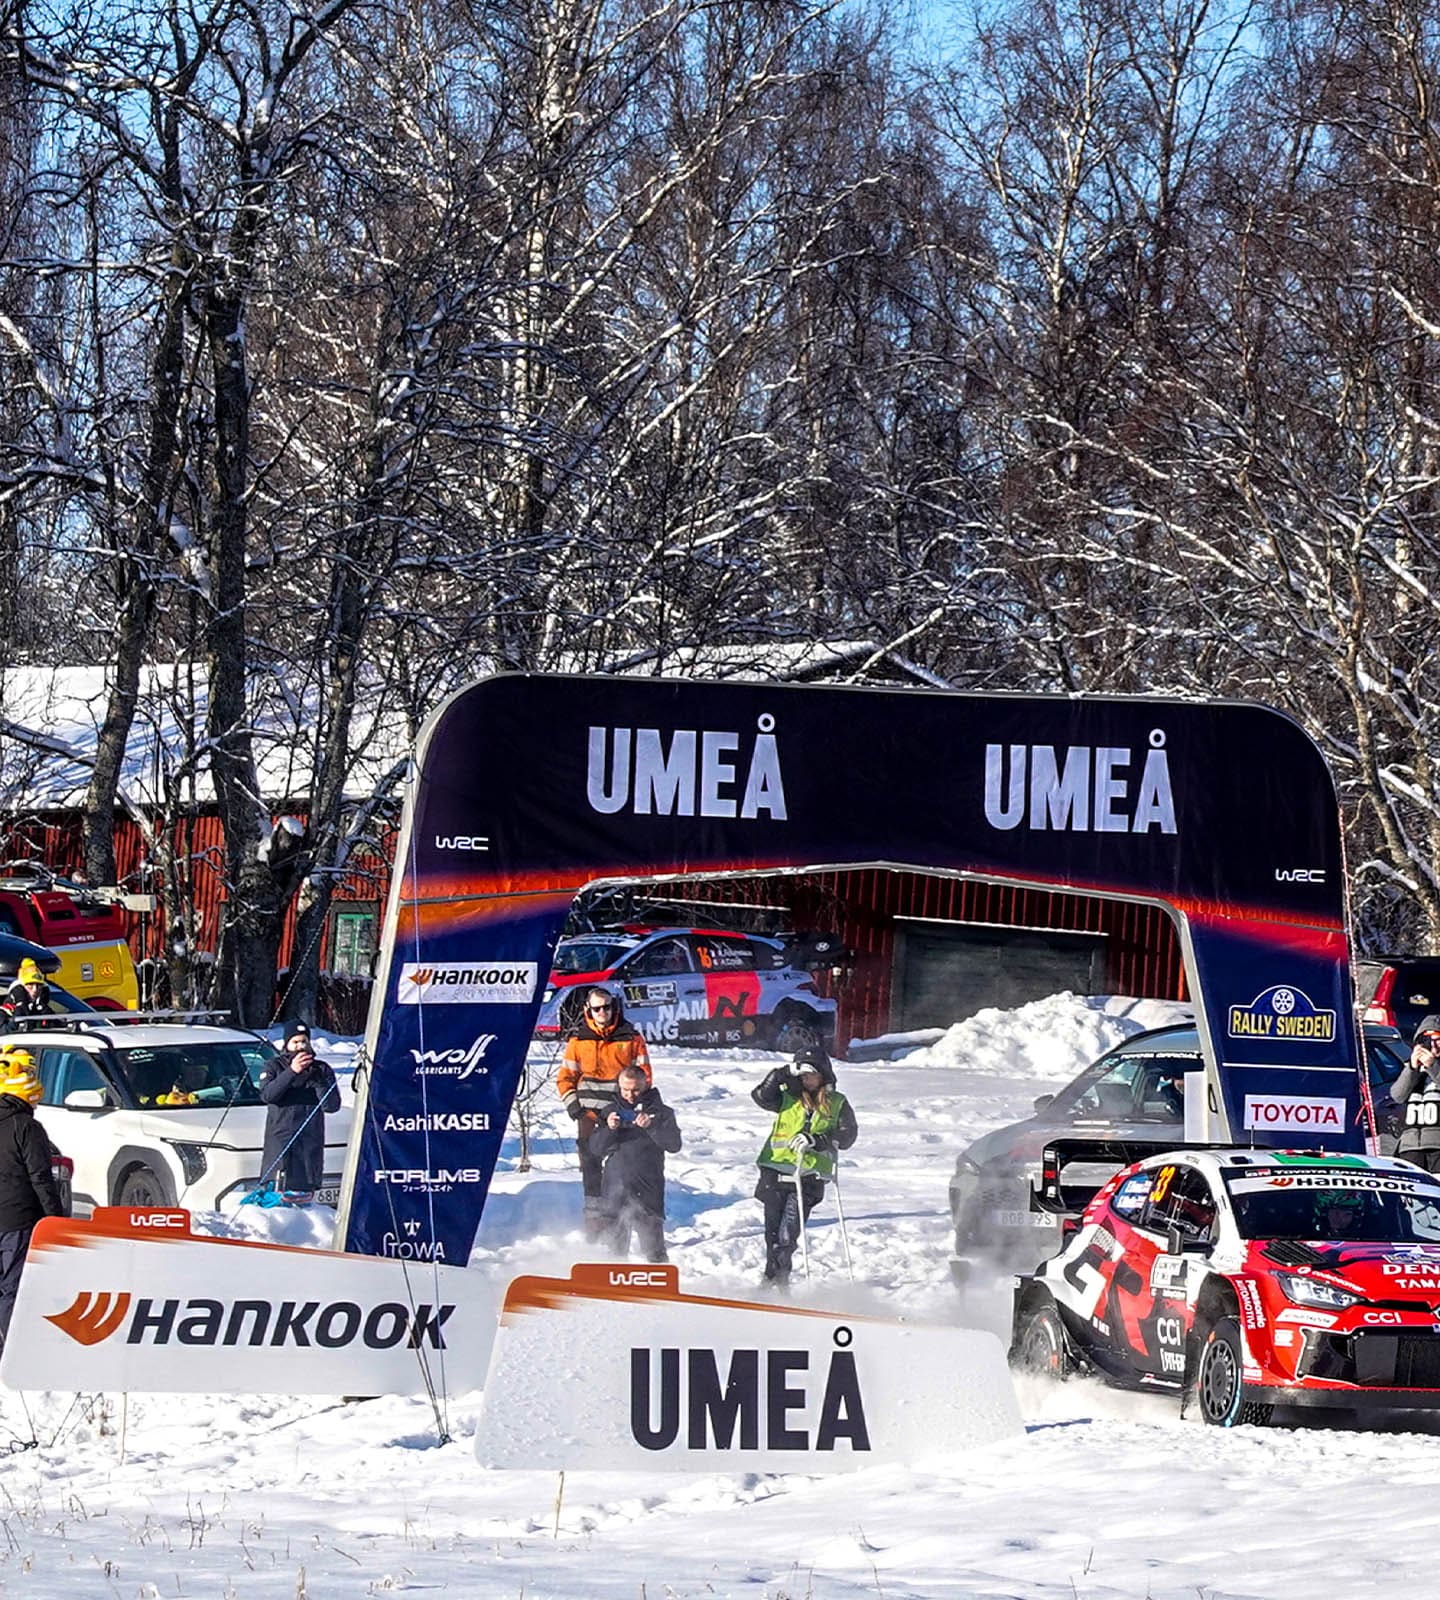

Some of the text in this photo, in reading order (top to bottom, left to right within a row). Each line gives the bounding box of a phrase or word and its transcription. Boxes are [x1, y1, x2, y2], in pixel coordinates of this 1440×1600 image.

[587, 713, 788, 821] UMEÅ
[984, 728, 1178, 835] UMEÅ
[435, 835, 489, 850] WRC
[1275, 869, 1326, 883] WRC
[1231, 1010, 1333, 1038] RALLY SWEDEN
[415, 1065, 463, 1076] LUBRICANTS
[1250, 1103, 1339, 1125] TOYOTA
[374, 1168, 481, 1184] FORUM8
[1149, 1165, 1176, 1203] 33
[130, 1213, 184, 1227] WRC
[609, 1271, 667, 1286] WRC
[1248, 1279, 1266, 1329] Panasonic
[630, 1325, 872, 1452] UMEÅ
